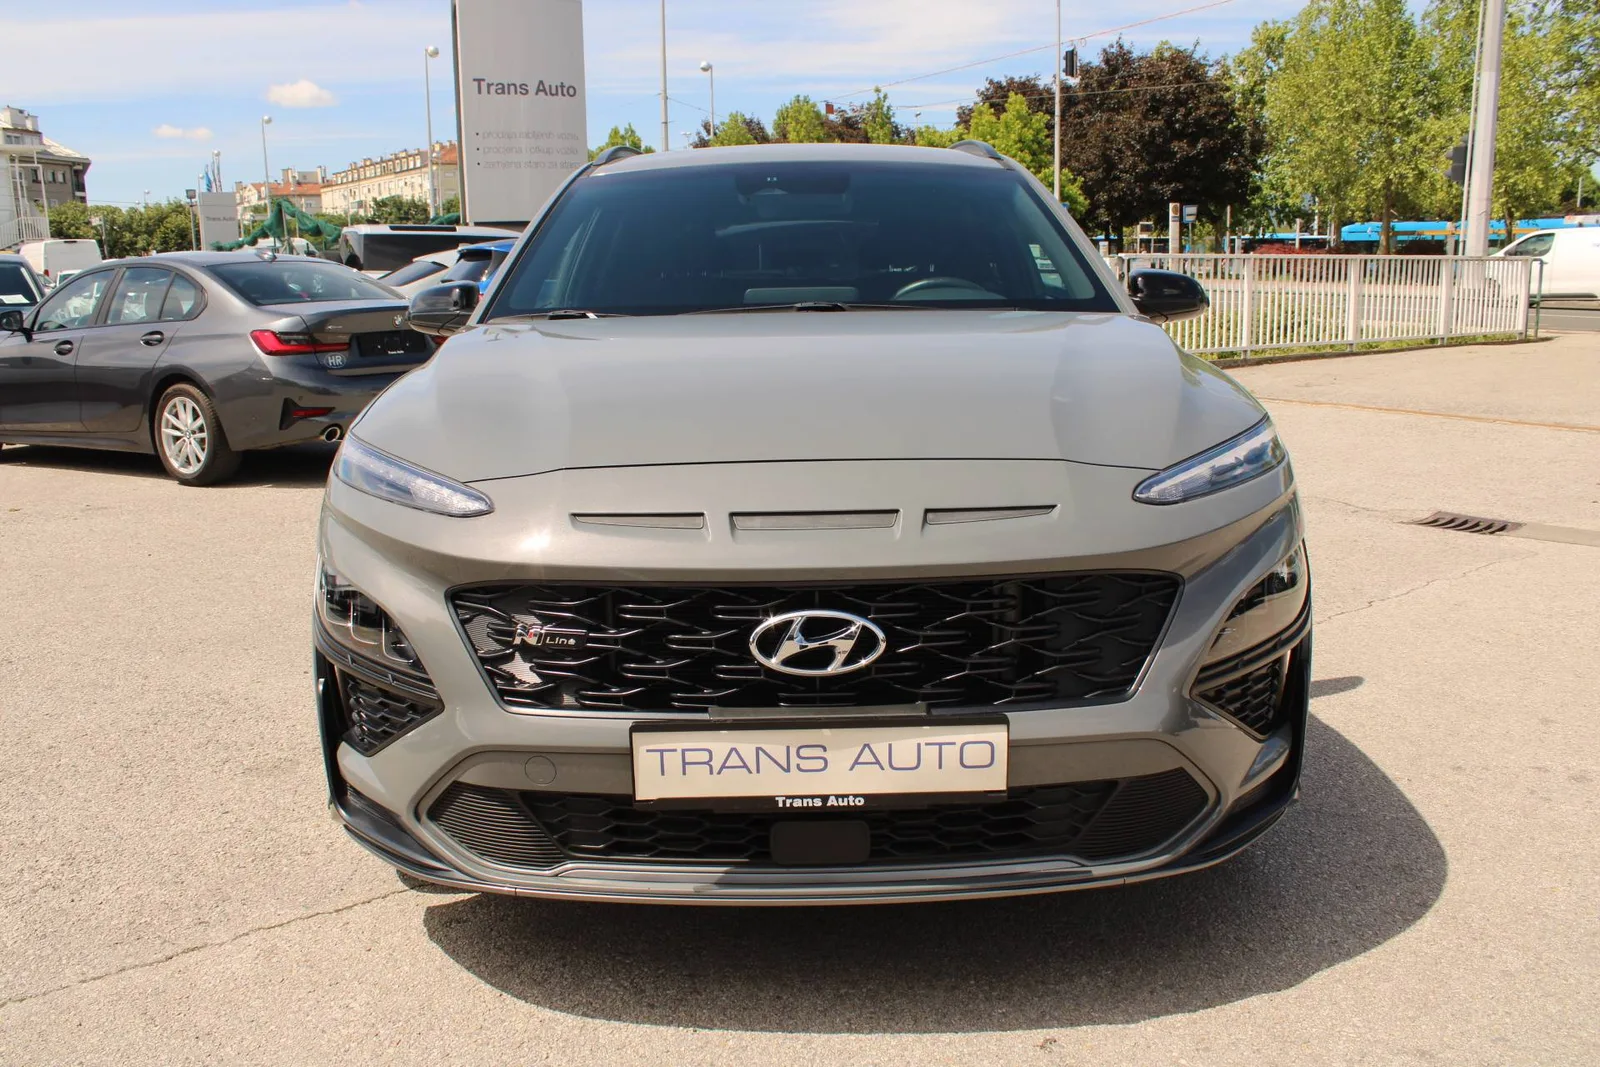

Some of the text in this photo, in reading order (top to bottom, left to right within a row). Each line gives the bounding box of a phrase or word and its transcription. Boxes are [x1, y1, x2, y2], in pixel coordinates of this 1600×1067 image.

[472, 78, 577, 98] Trans Auto
[328, 355, 343, 366] HR
[545, 636, 577, 646] Line
[645, 740, 996, 777] TRANS AUTO
[775, 795, 865, 808] Trans Auto
